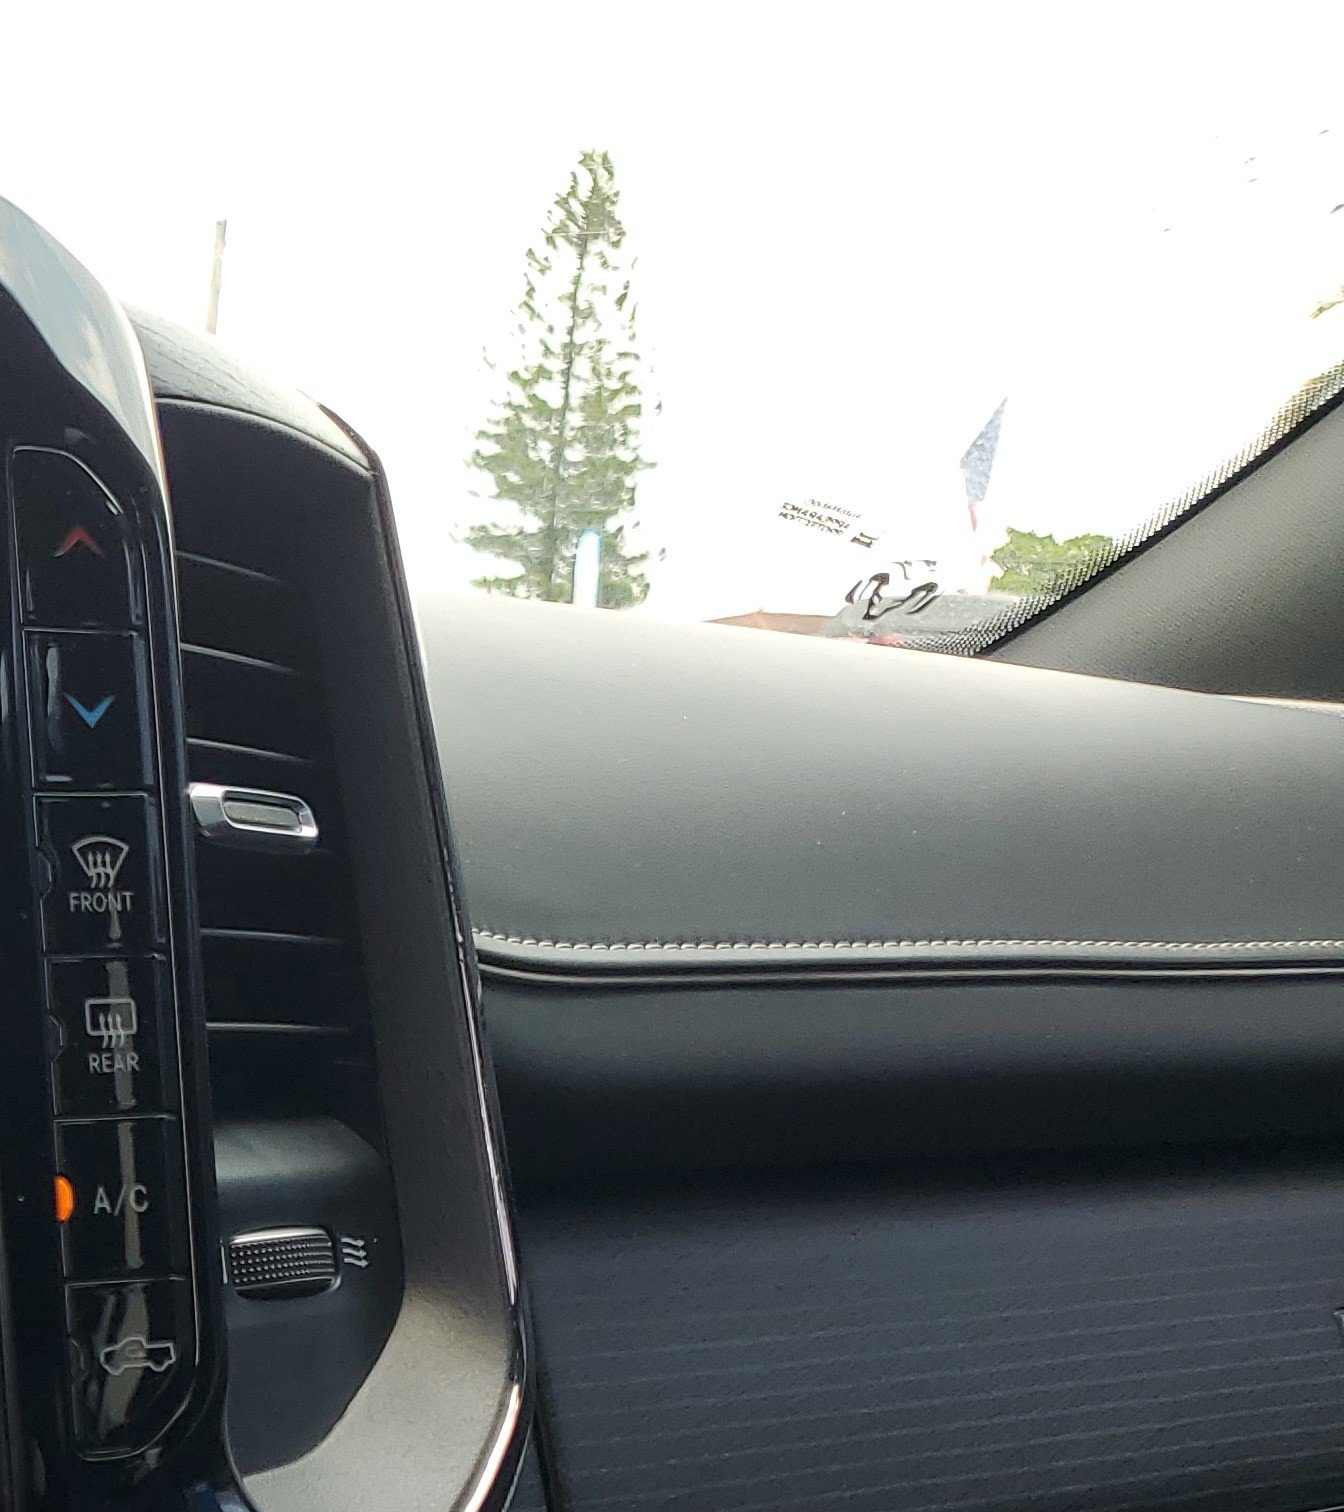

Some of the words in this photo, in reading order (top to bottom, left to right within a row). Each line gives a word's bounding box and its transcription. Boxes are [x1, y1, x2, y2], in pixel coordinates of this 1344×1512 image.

[69, 891, 134, 912] FRONT
[88, 1052, 141, 1074] REAR
[93, 1185, 150, 1215] A/C
